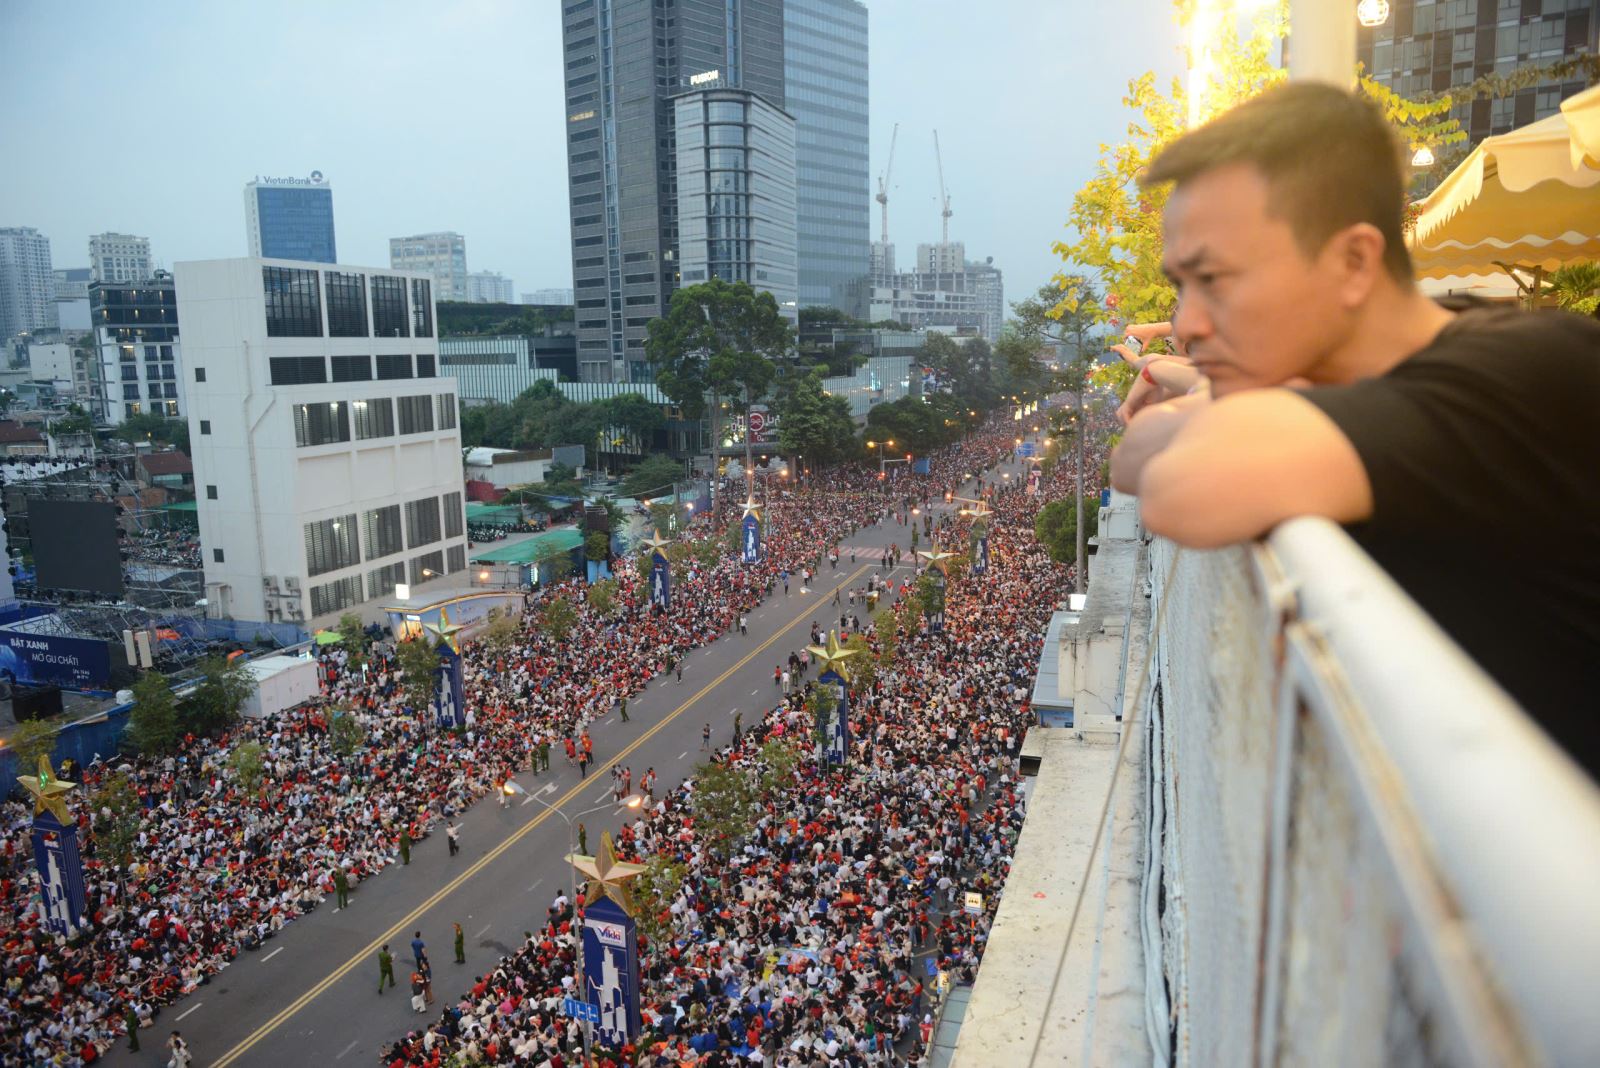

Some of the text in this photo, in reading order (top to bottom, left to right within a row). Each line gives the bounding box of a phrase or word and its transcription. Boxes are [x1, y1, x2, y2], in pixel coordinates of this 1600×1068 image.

[690, 70, 718, 85] FUSION
[264, 176, 311, 185] VietinBank
[26, 640, 49, 651] XANH
[45, 654, 57, 664] GU
[598, 926, 621, 940] Vikki
